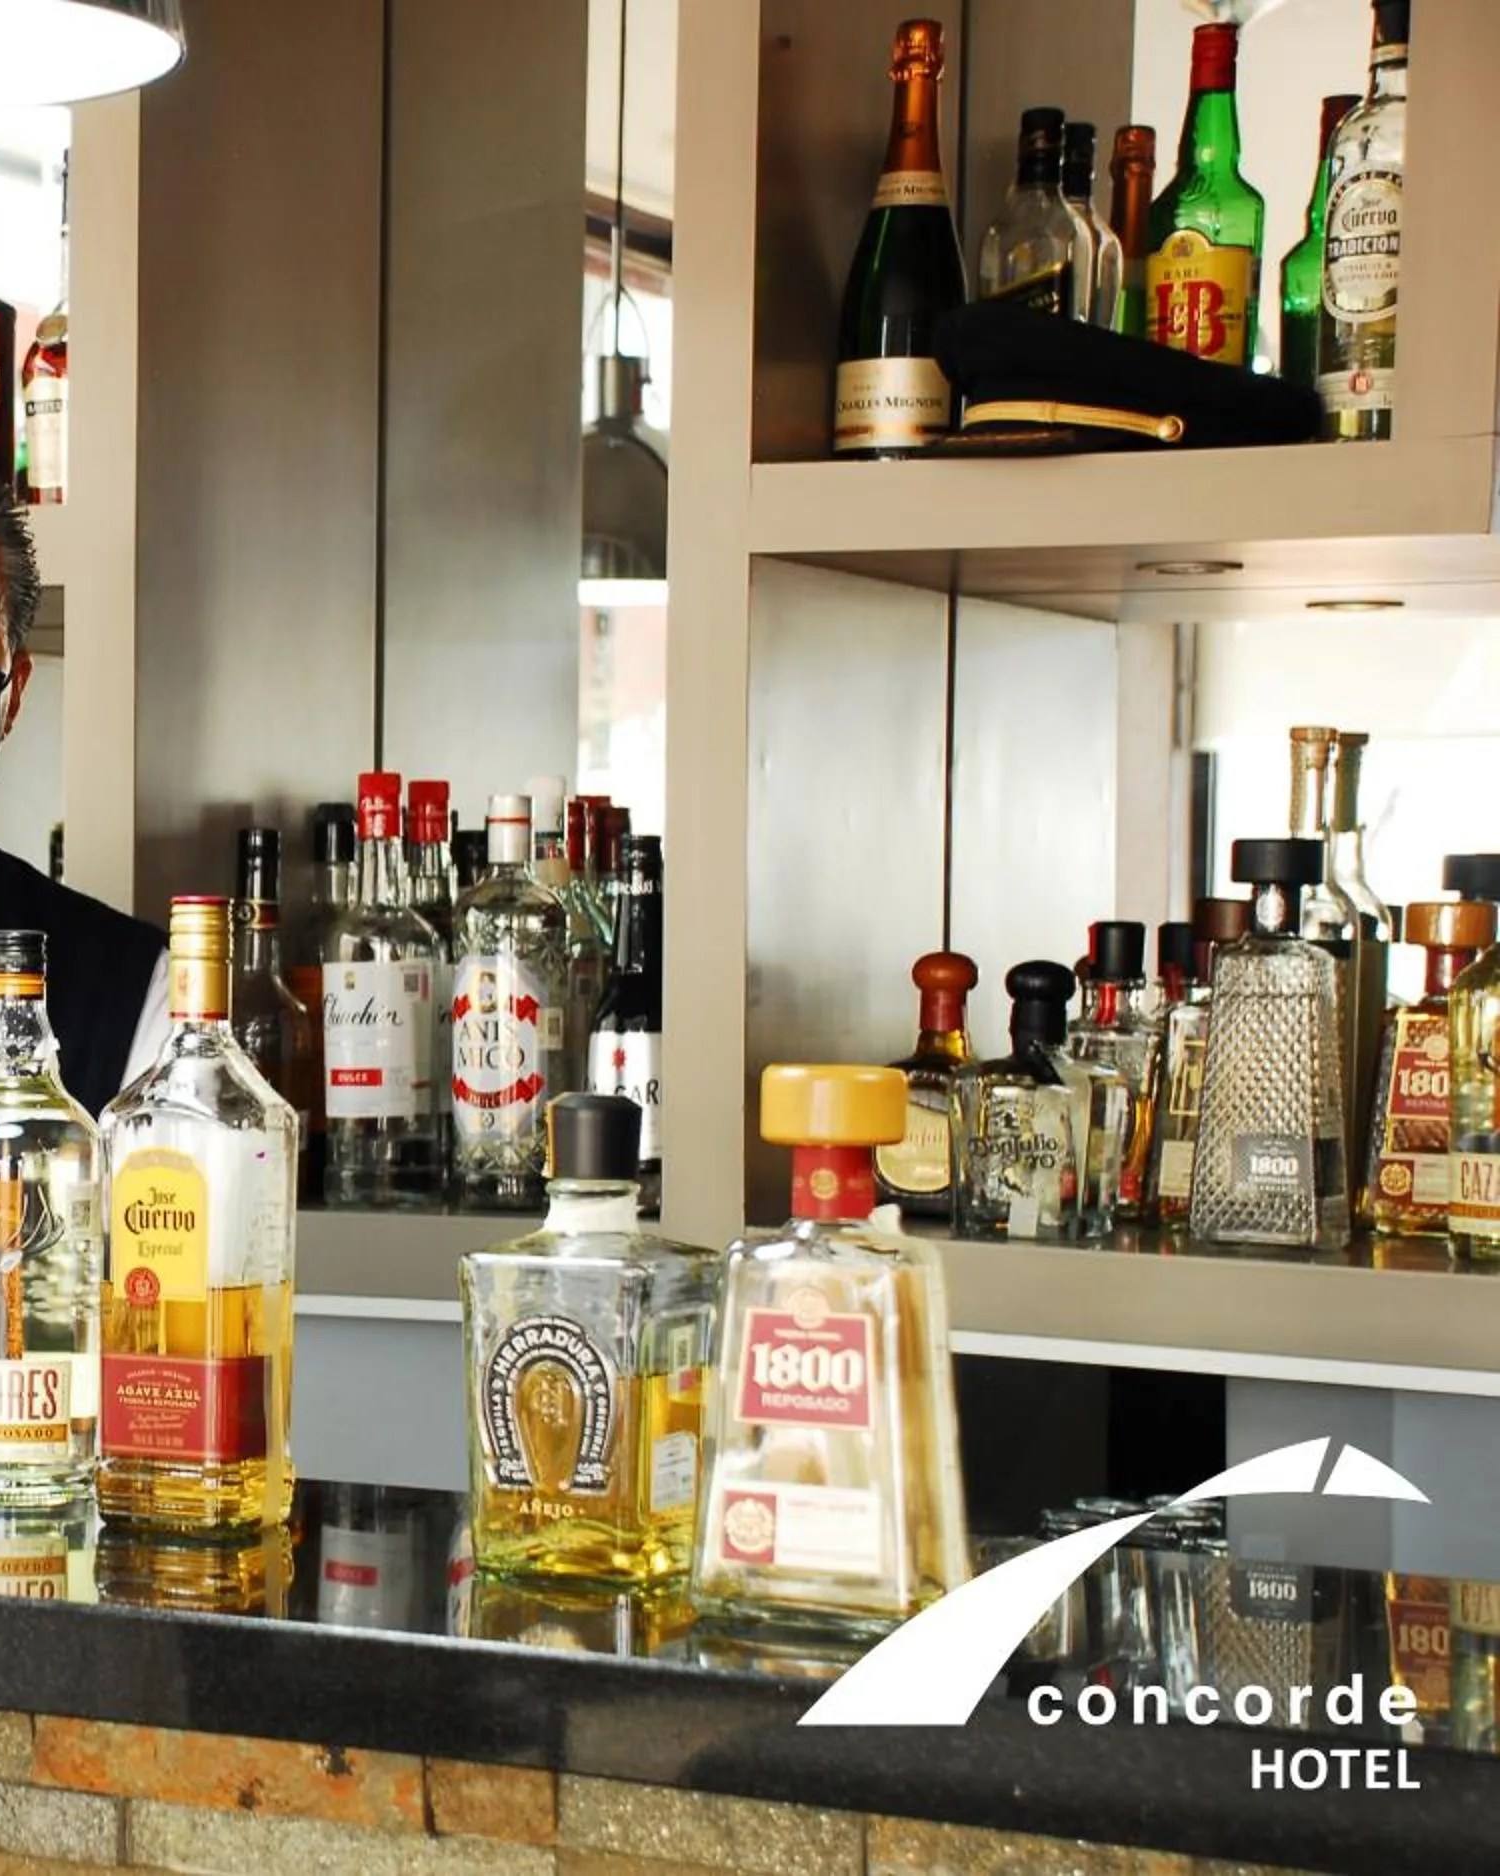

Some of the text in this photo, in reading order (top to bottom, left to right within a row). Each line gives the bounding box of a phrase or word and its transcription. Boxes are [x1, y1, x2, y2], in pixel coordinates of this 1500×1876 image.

[1341, 207, 1398, 233] Cuervo
[1248, 1154, 1299, 1176] 1800
[124, 1199, 195, 1236] Cuervo
[137, 1240, 184, 1260] Especial
[493, 1327, 602, 1383] HERRADURA
[750, 1341, 865, 1396] 1800
[116, 1384, 161, 1397] AGAVE
[165, 1388, 202, 1401] AZUL
[760, 1391, 851, 1414] REPOSADO
[518, 1497, 575, 1521] AÑEJO
